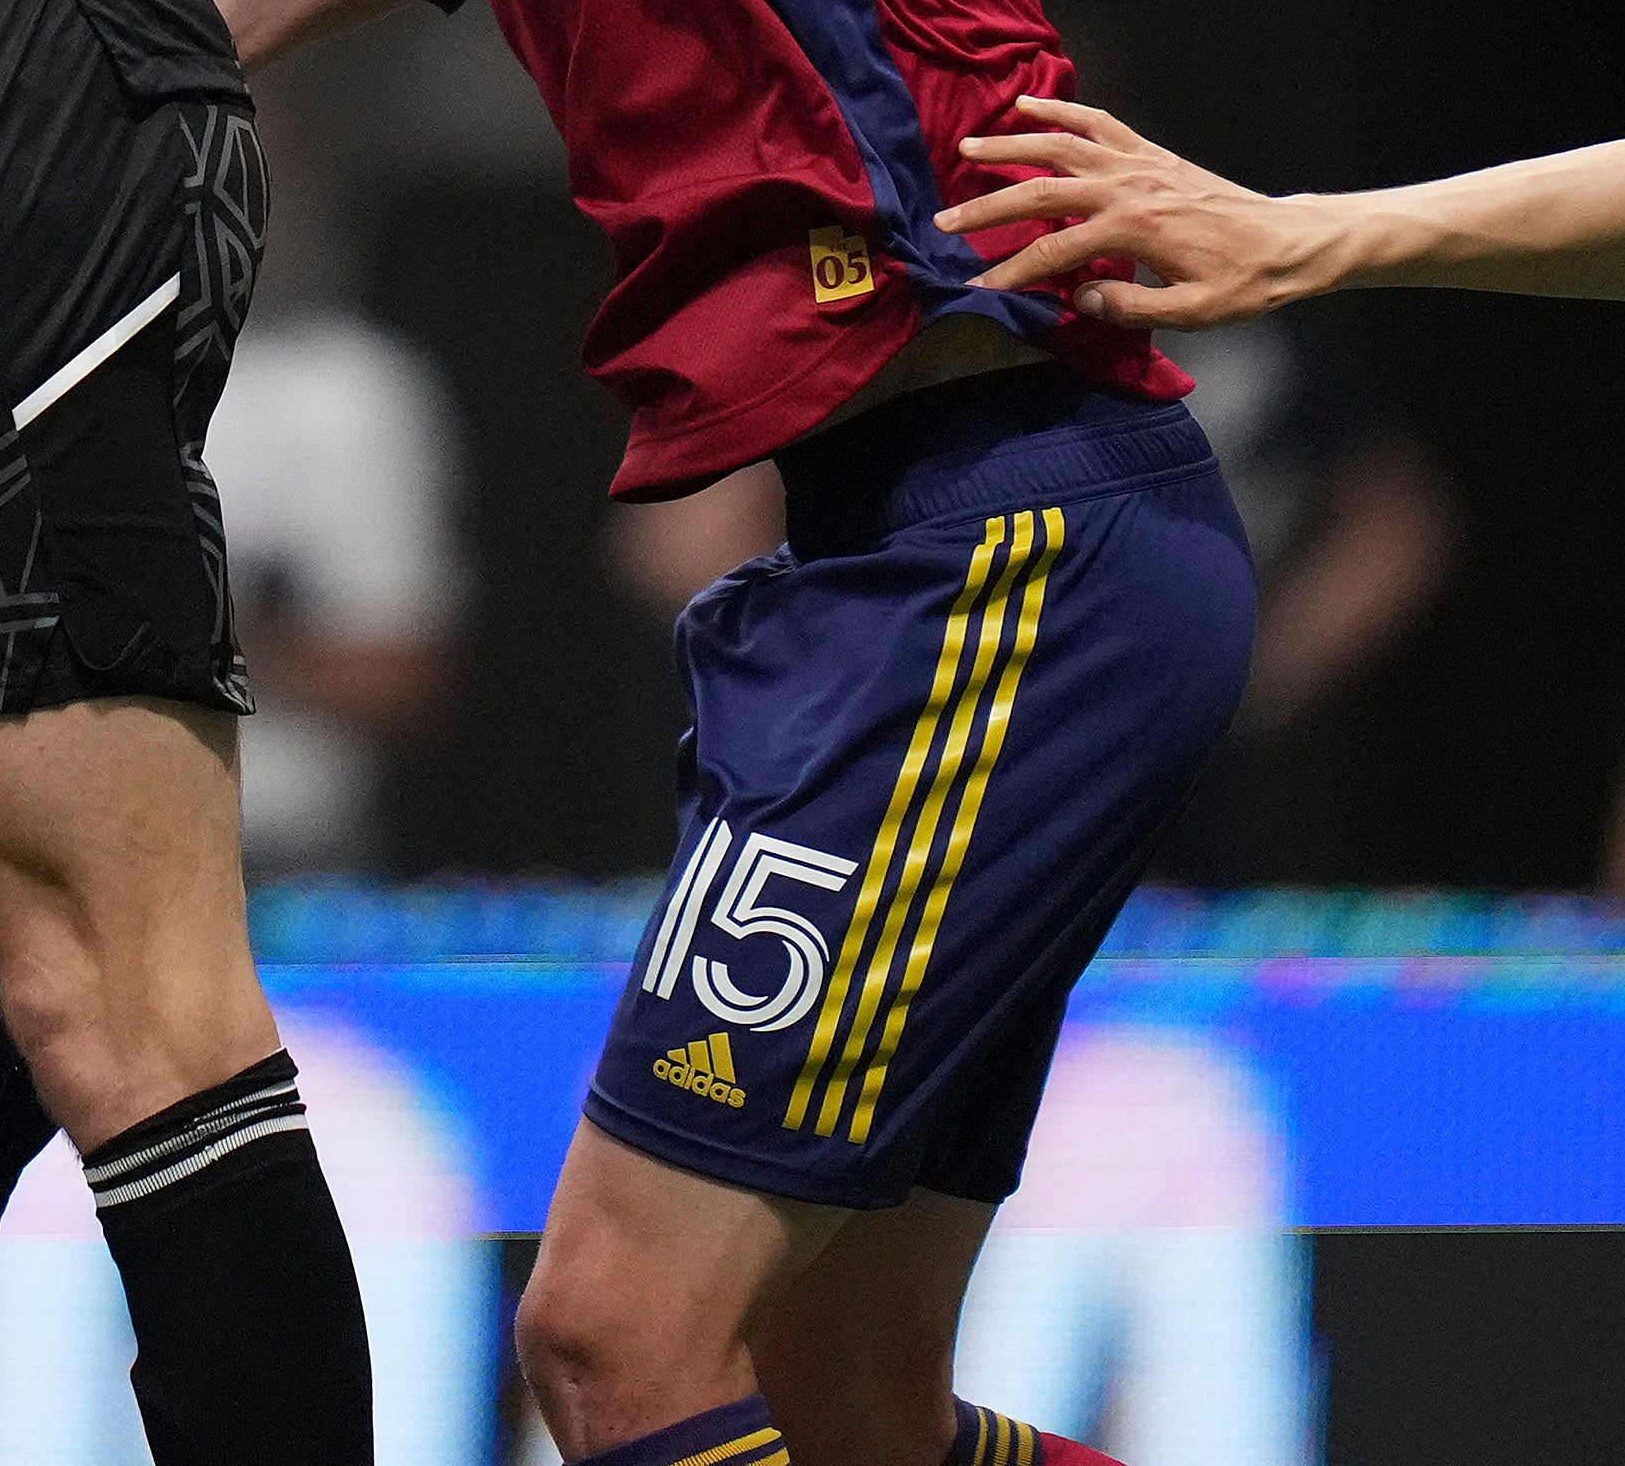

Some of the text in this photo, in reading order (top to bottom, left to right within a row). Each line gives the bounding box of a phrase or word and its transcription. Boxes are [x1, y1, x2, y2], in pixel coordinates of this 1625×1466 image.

[816, 251, 867, 289] 05
[641, 817, 860, 1032] 15
[652, 1058, 747, 1109] adidas
